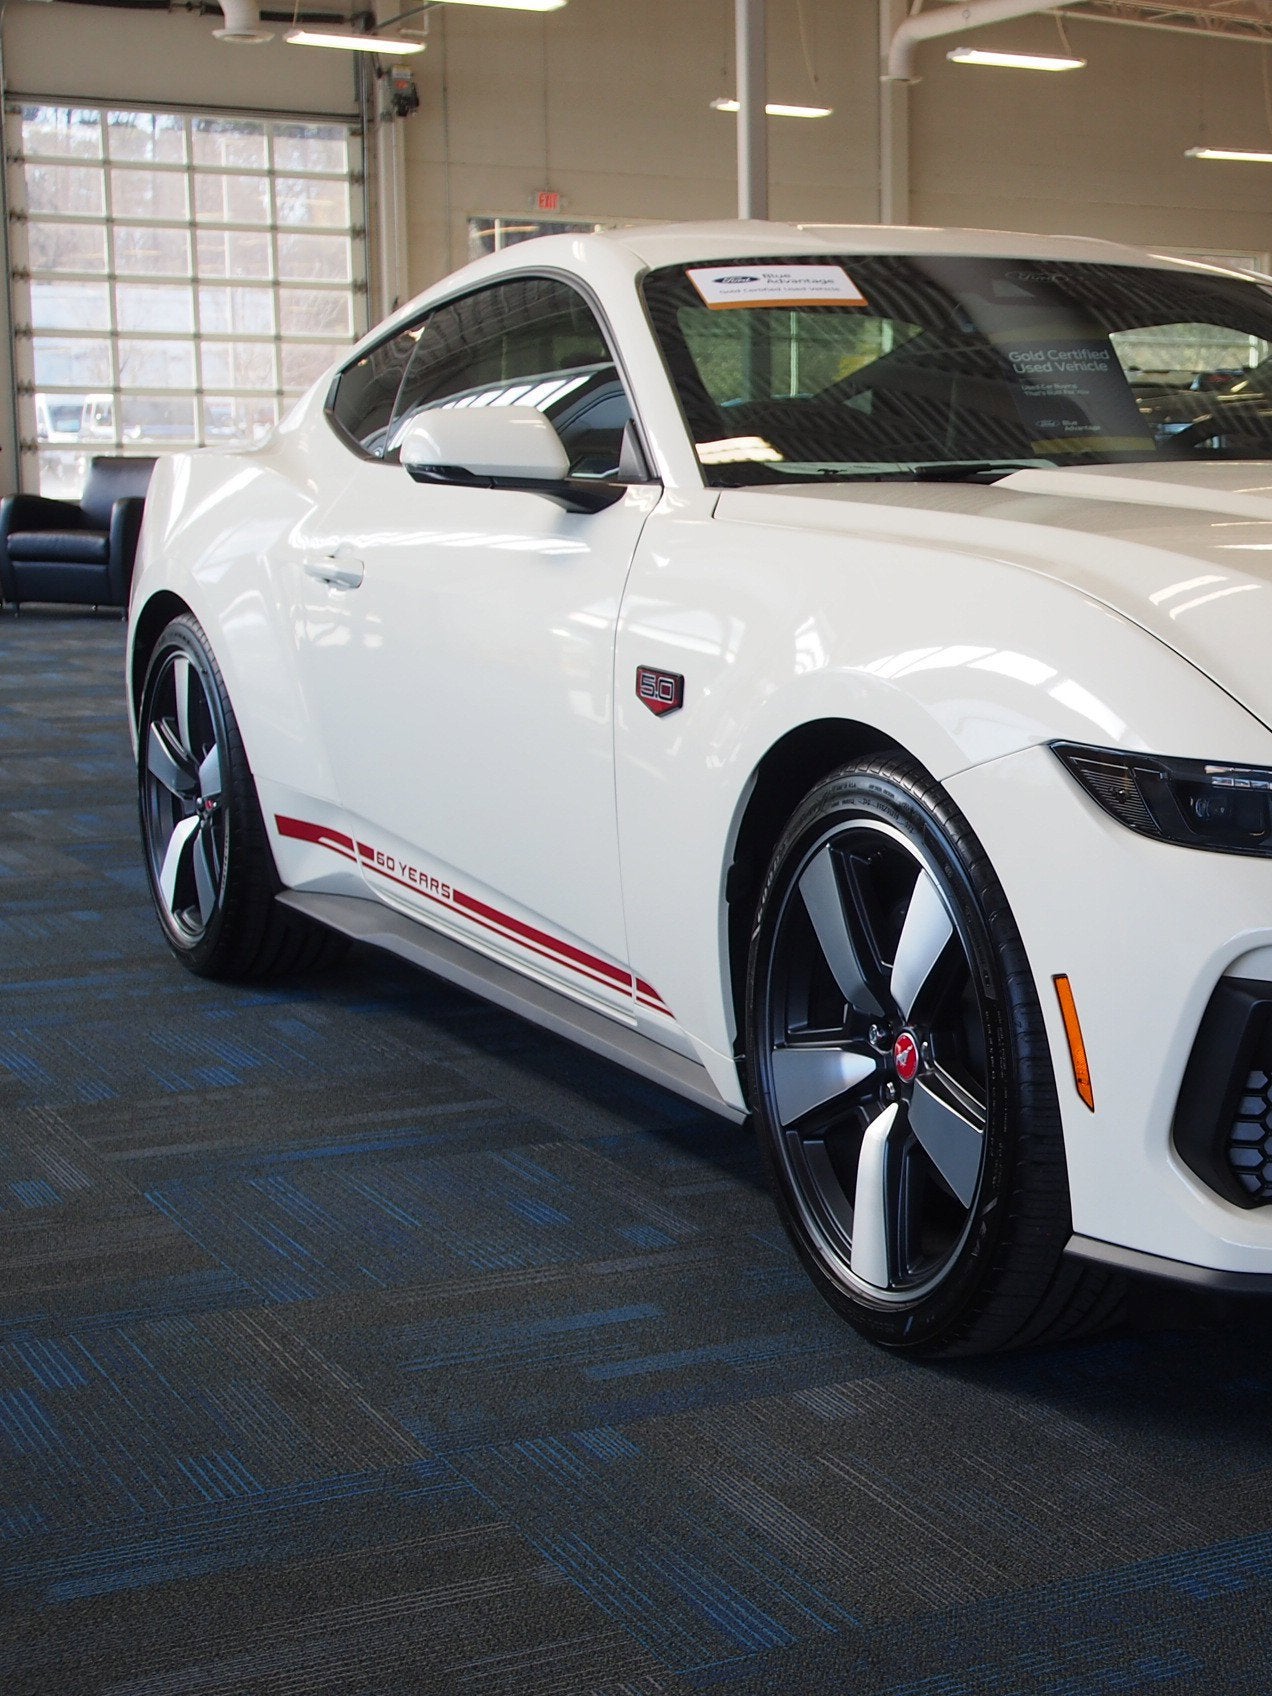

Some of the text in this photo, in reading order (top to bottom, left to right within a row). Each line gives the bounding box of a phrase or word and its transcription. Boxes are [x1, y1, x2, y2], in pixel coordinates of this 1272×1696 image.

[539, 192, 559, 210] EXIT
[1008, 349, 1110, 362] Gold Certified
[1012, 361, 1108, 374] Used Vehicle
[640, 672, 675, 704] 5.0
[377, 851, 450, 899] 60 YEARS
